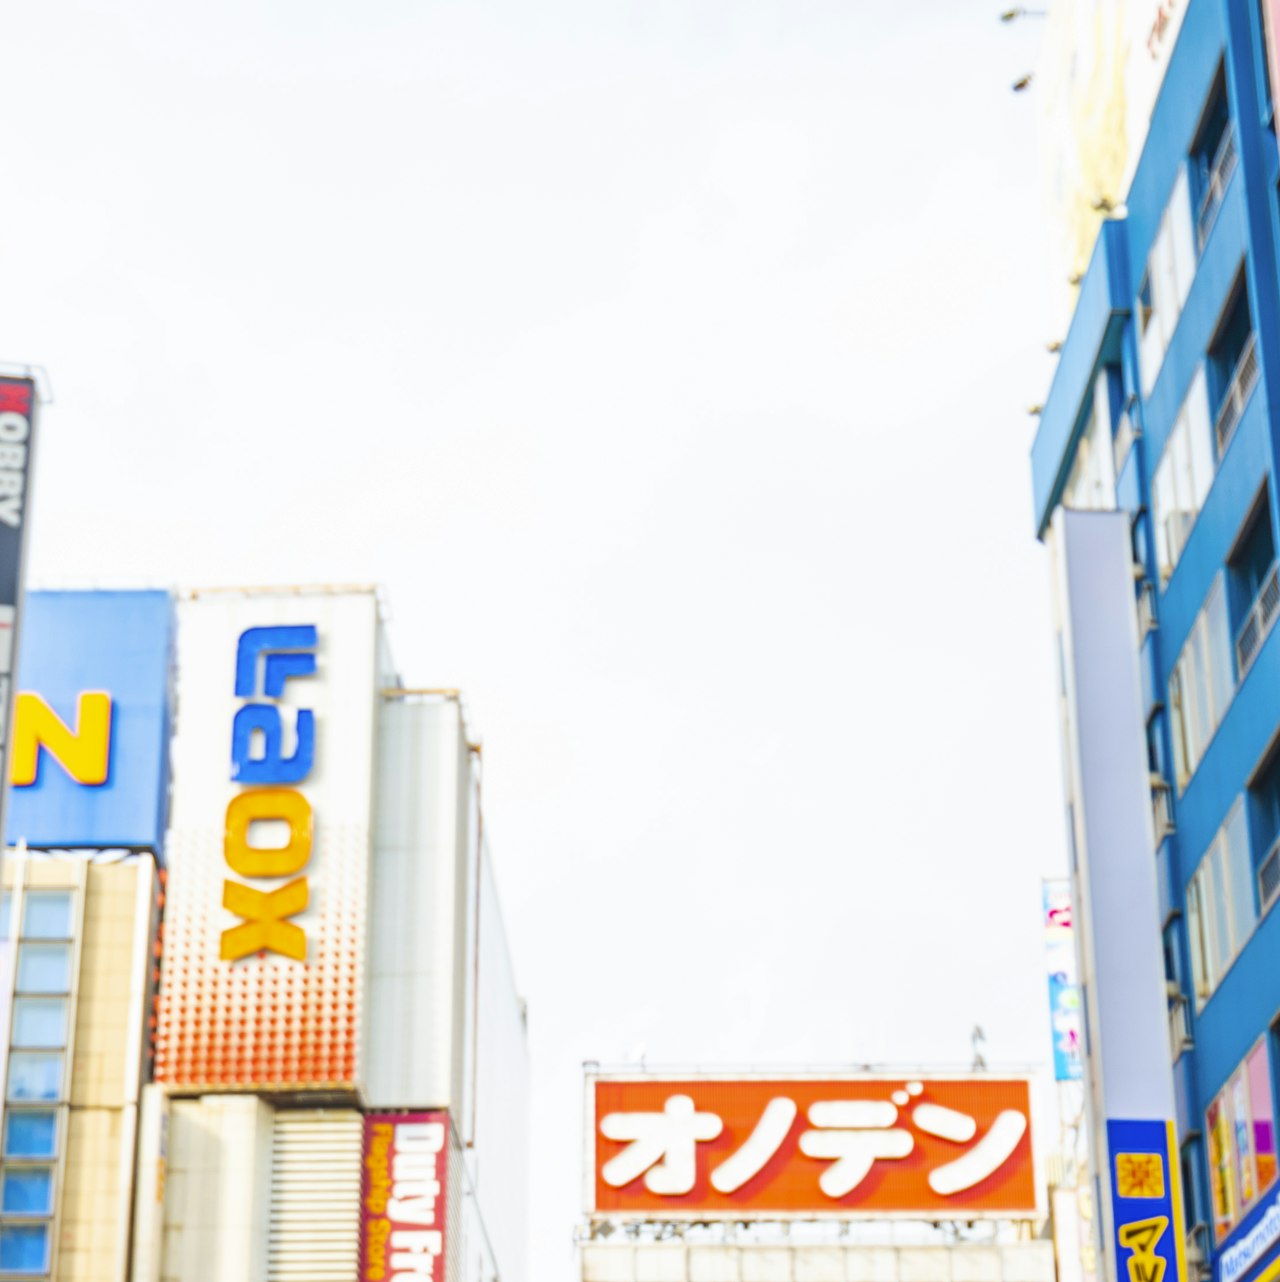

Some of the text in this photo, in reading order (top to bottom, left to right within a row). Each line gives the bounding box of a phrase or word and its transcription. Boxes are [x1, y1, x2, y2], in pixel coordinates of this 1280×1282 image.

[387, 1121, 446, 1225] Duty
[600, 1080, 1027, 1199] オノデン
[365, 1122, 394, 1282] Flagship Store
